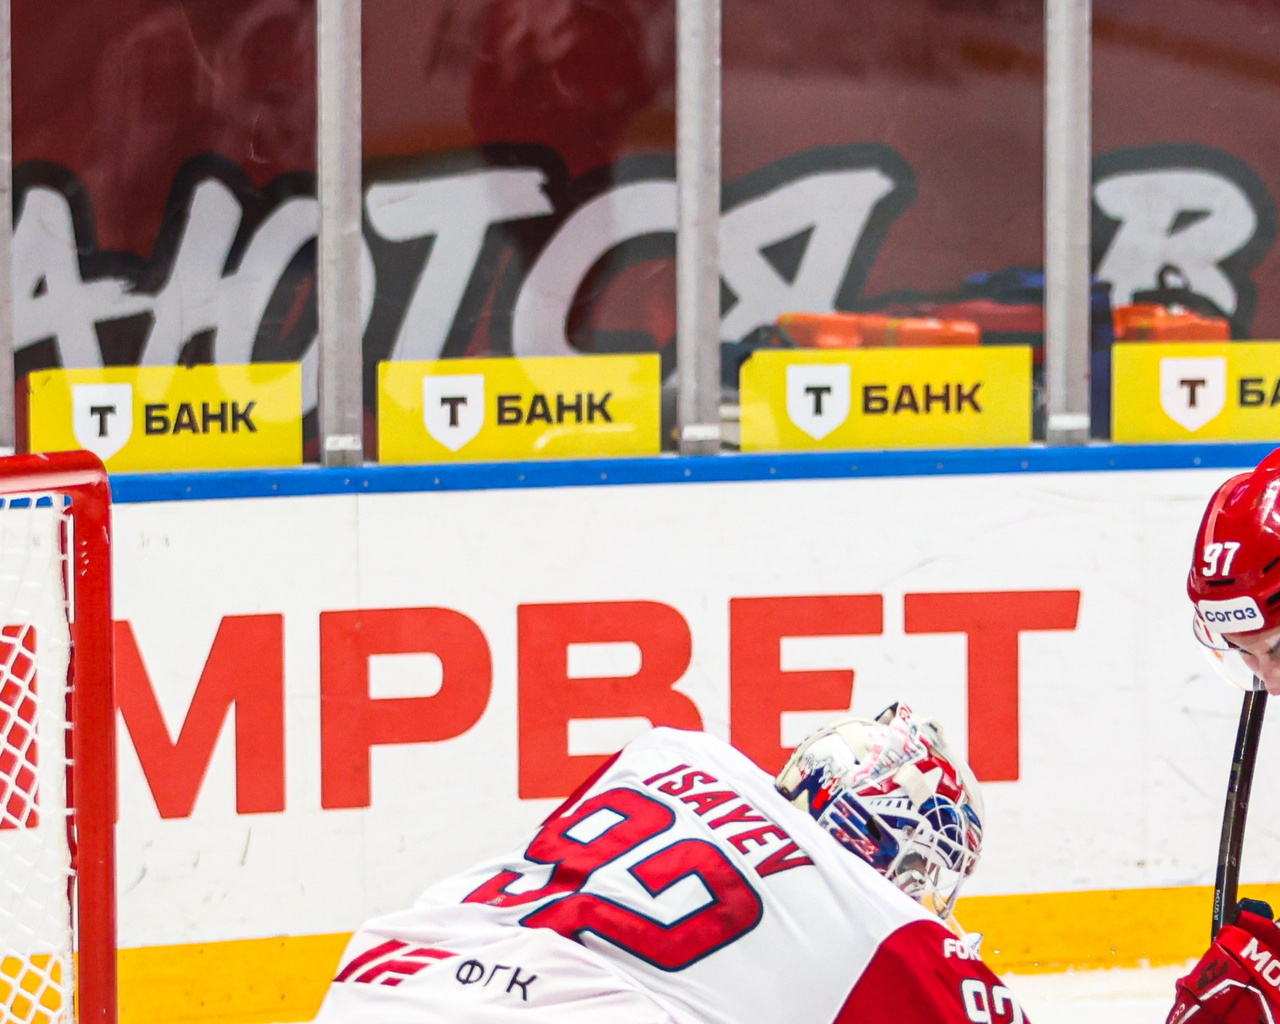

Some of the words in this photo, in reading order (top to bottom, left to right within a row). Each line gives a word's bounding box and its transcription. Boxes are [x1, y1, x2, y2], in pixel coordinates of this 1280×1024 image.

[497, 391, 614, 427] БАНК
[862, 382, 984, 414] БАНК
[144, 400, 258, 436] БАНК
[1202, 542, 1241, 577] 97
[642, 763, 816, 879] ISAYEV
[464, 787, 764, 972] 92
[455, 959, 538, 1001] ФГК
